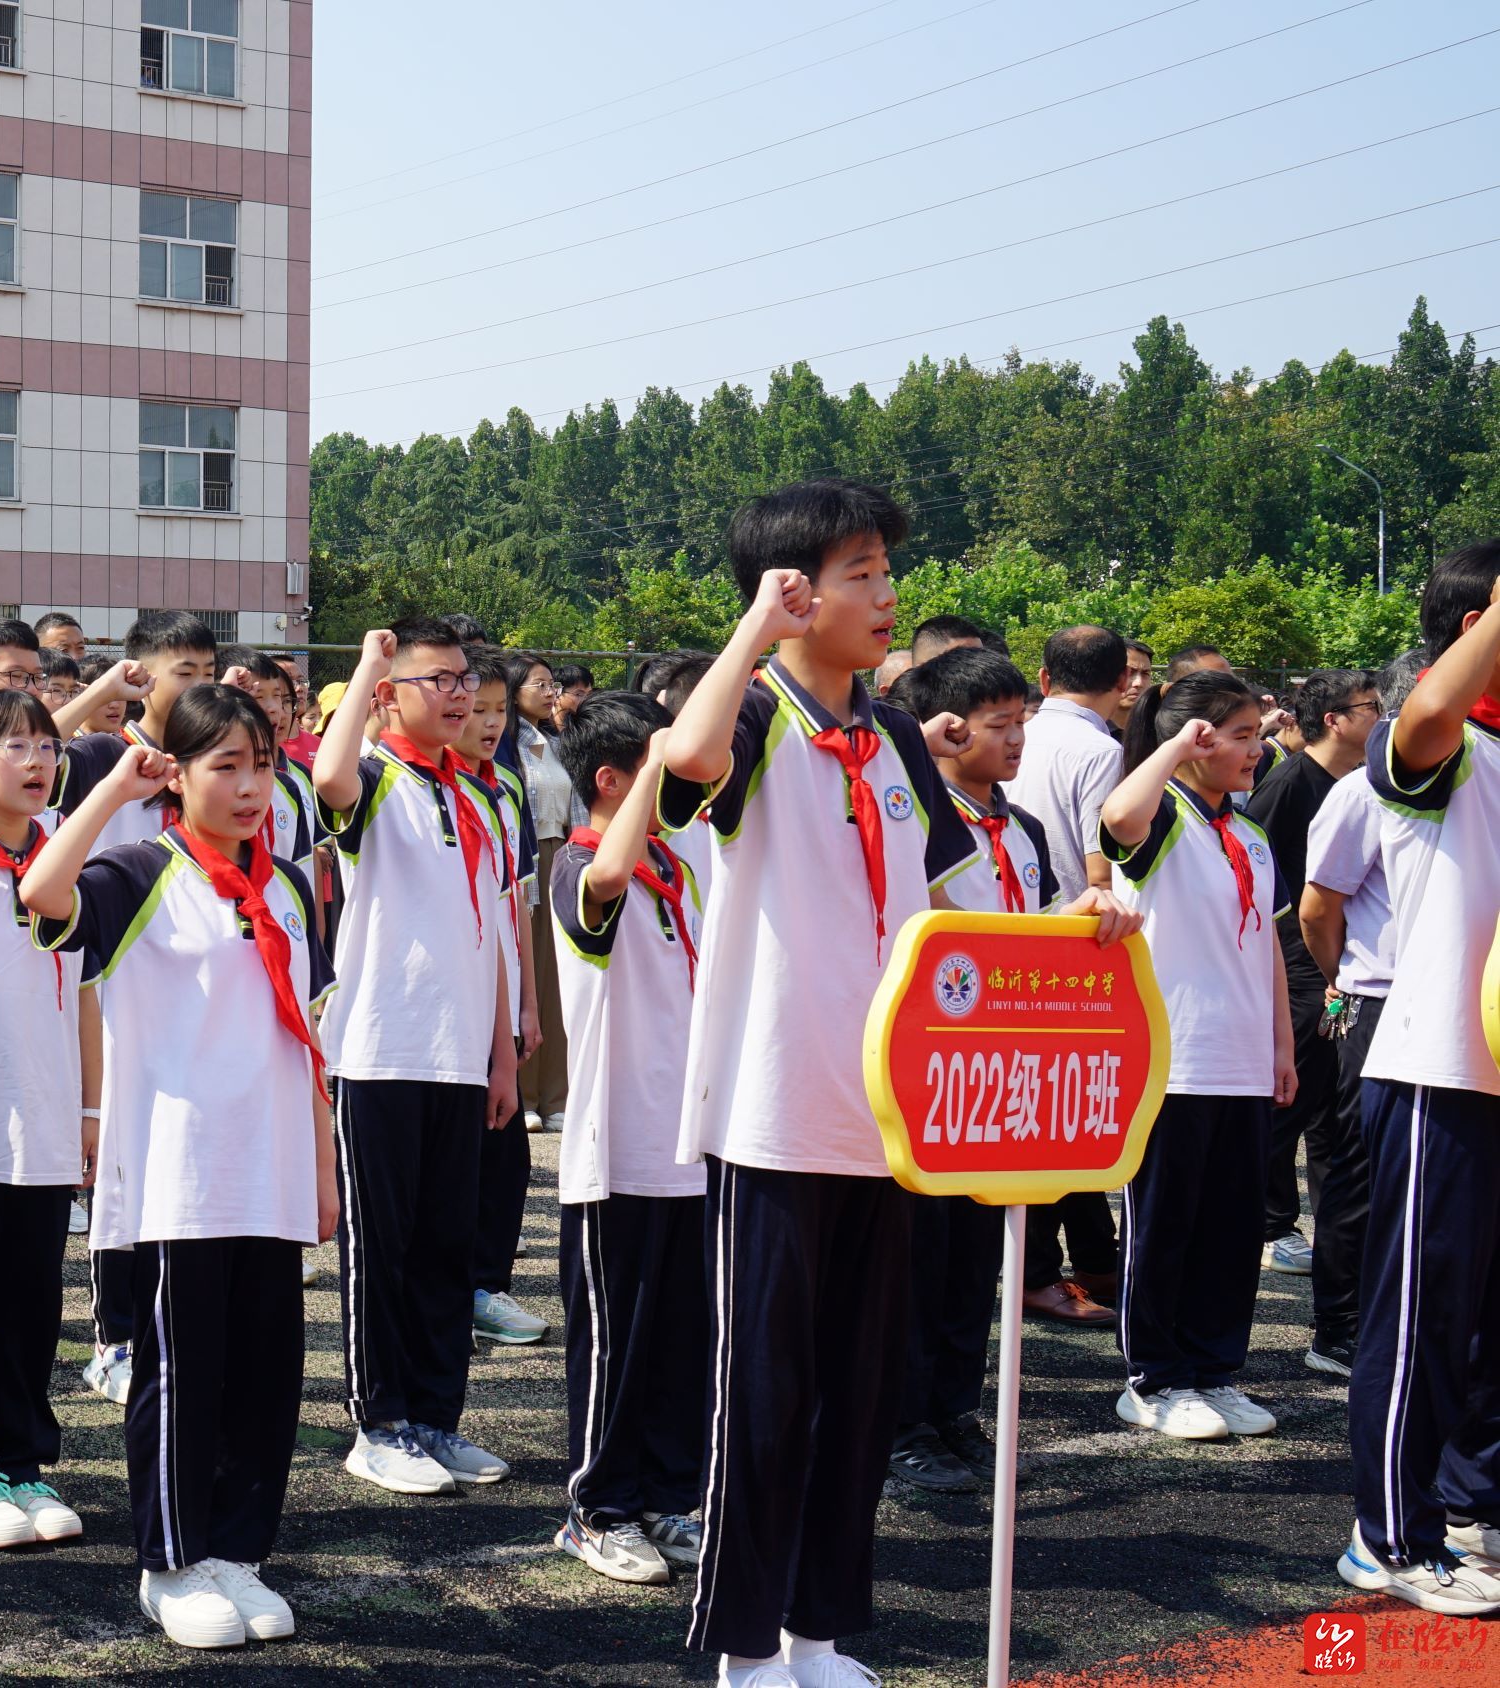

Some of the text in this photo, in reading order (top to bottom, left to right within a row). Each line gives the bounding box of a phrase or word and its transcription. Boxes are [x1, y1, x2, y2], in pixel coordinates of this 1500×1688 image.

[988, 966, 1115, 997] 临沂第十四中学
[987, 1001, 1114, 1012] LINYI NO.14 MIDDLE SCHOOL
[923, 1049, 1121, 1146] 2022级10班
